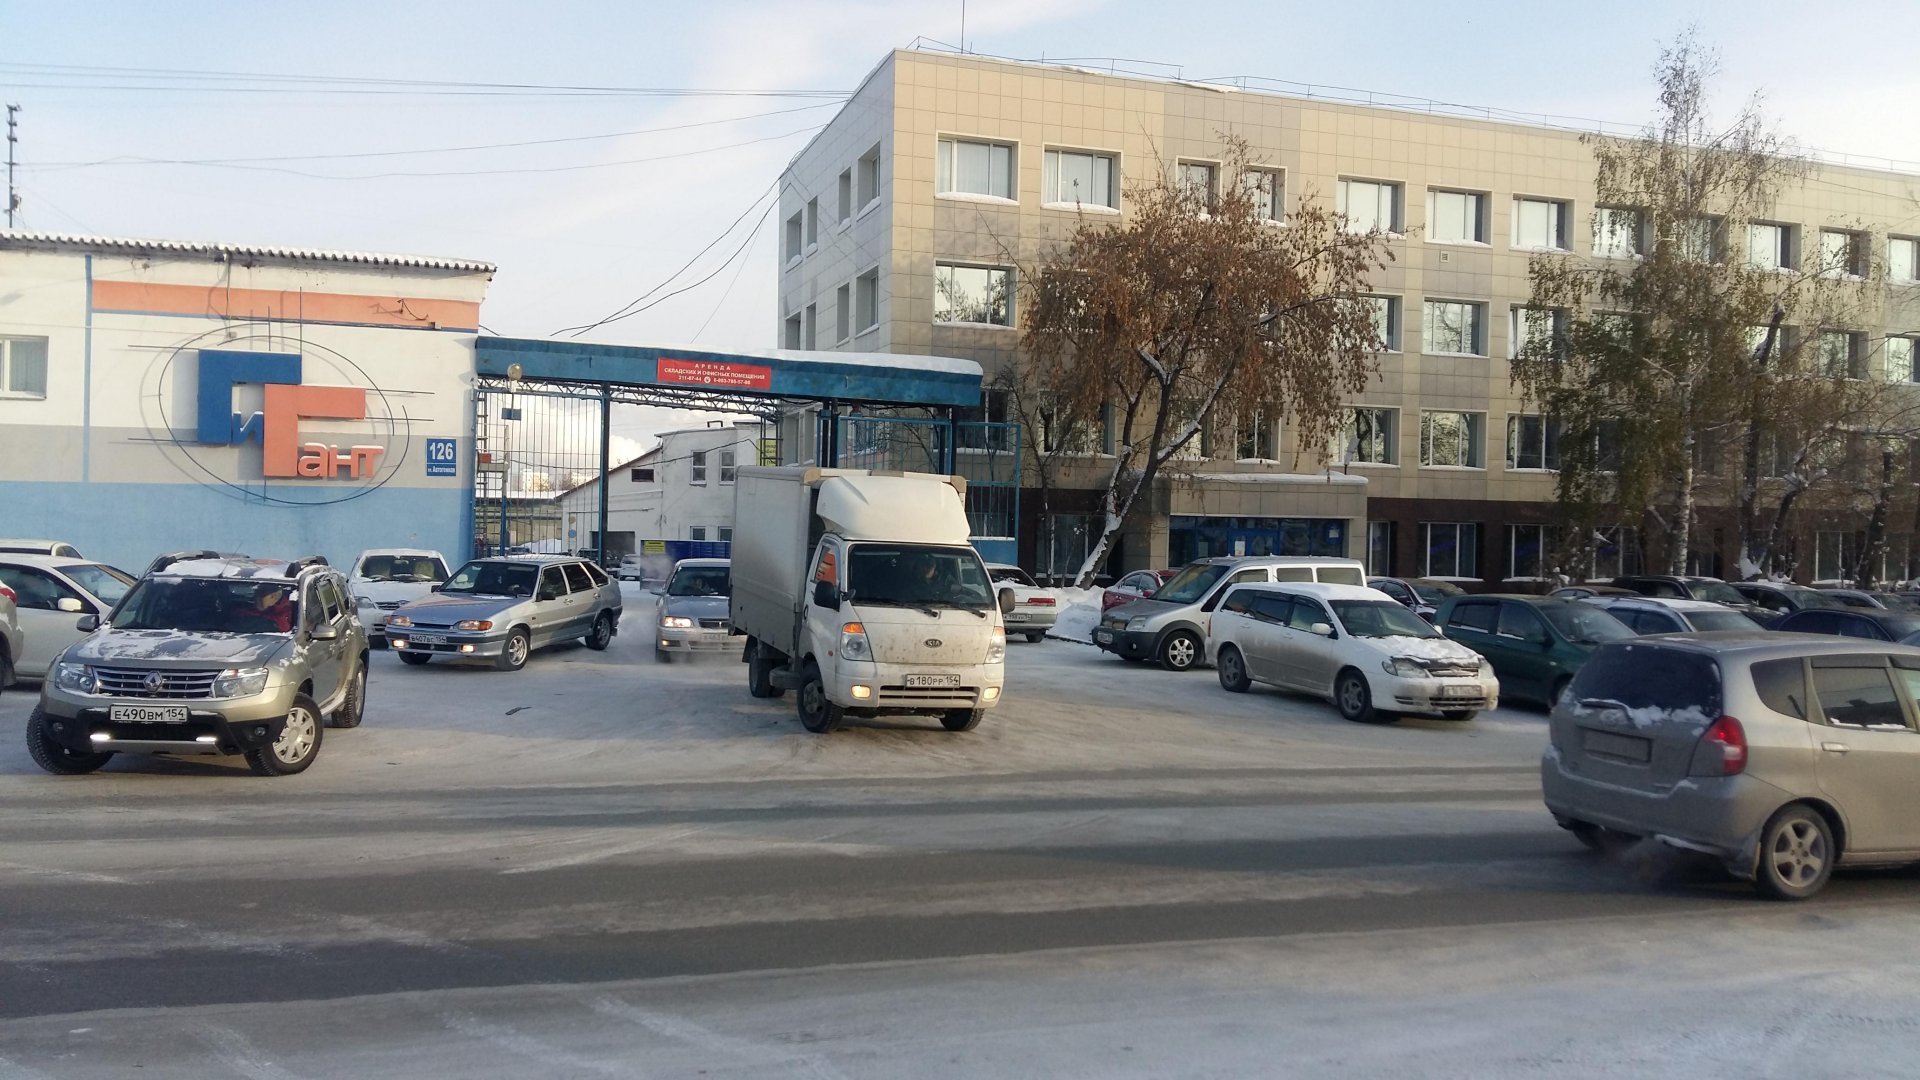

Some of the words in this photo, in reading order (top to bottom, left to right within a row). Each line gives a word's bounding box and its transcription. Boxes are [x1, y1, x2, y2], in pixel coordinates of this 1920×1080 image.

[694, 363, 731, 371] АРЕНДА
[664, 367, 697, 375] СКЛАДСКИХ
[730, 372, 765, 380] ПОМЕЩЕНИЙ
[430, 442, 453, 460] 126
[926, 639, 942, 647] KIA
[909, 676, 944, 686] В180РР
[945, 676, 959, 684] 154
[114, 708, 164, 721] Е490ВМ
[165, 708, 184, 718] 154
